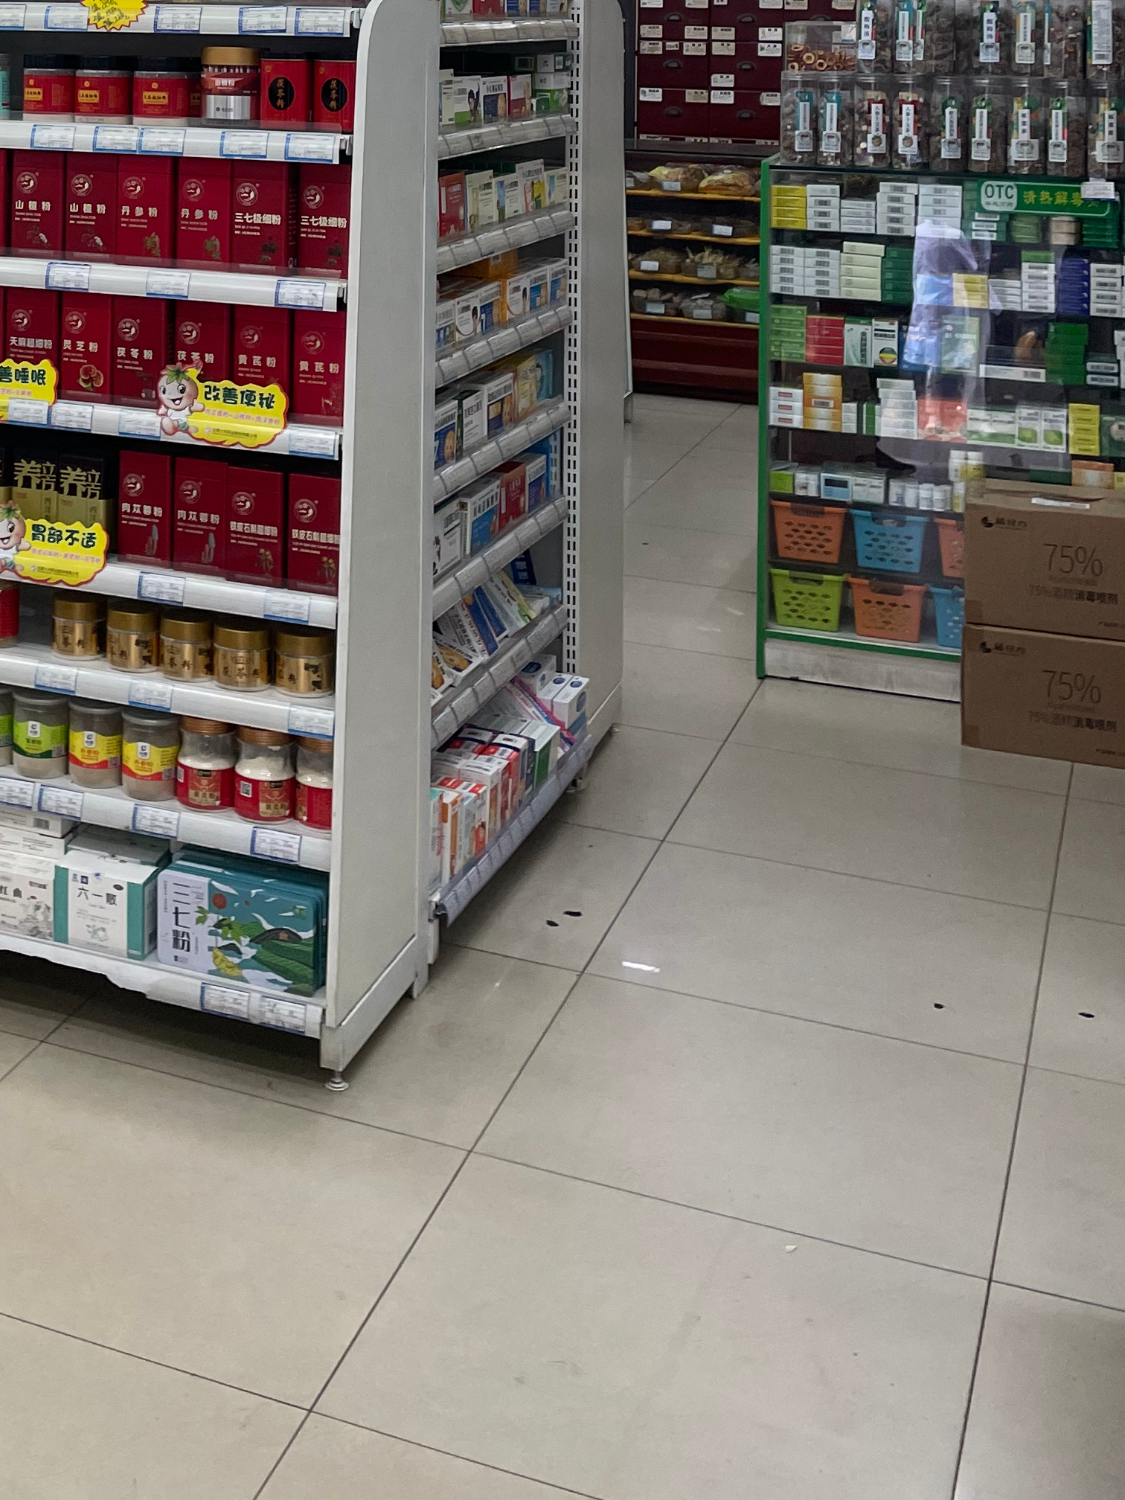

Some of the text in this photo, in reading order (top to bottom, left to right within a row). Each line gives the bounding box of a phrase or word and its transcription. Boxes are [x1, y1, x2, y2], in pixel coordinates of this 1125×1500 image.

[984, 184, 1015, 200] OTC
[15, 199, 51, 212] 山楂粉
[69, 202, 106, 215] 山楂粉
[121, 205, 158, 218] 丹参粉
[180, 208, 218, 220] 丹参粉
[62, 339, 98, 353] 灵芝粉
[117, 346, 153, 360] 茯苓粉
[238, 354, 276, 368] 黄芪粉
[299, 360, 340, 374] 黄芪粉
[204, 384, 276, 410] 改善便秘
[31, 524, 97, 549] 胃部不适
[1043, 543, 1103, 577] 75%
[1042, 670, 1101, 704] 75%
[0, 884, 23, 899] 红曲
[76, 886, 118, 907] 六一散
[172, 882, 191, 953] 三七粉
